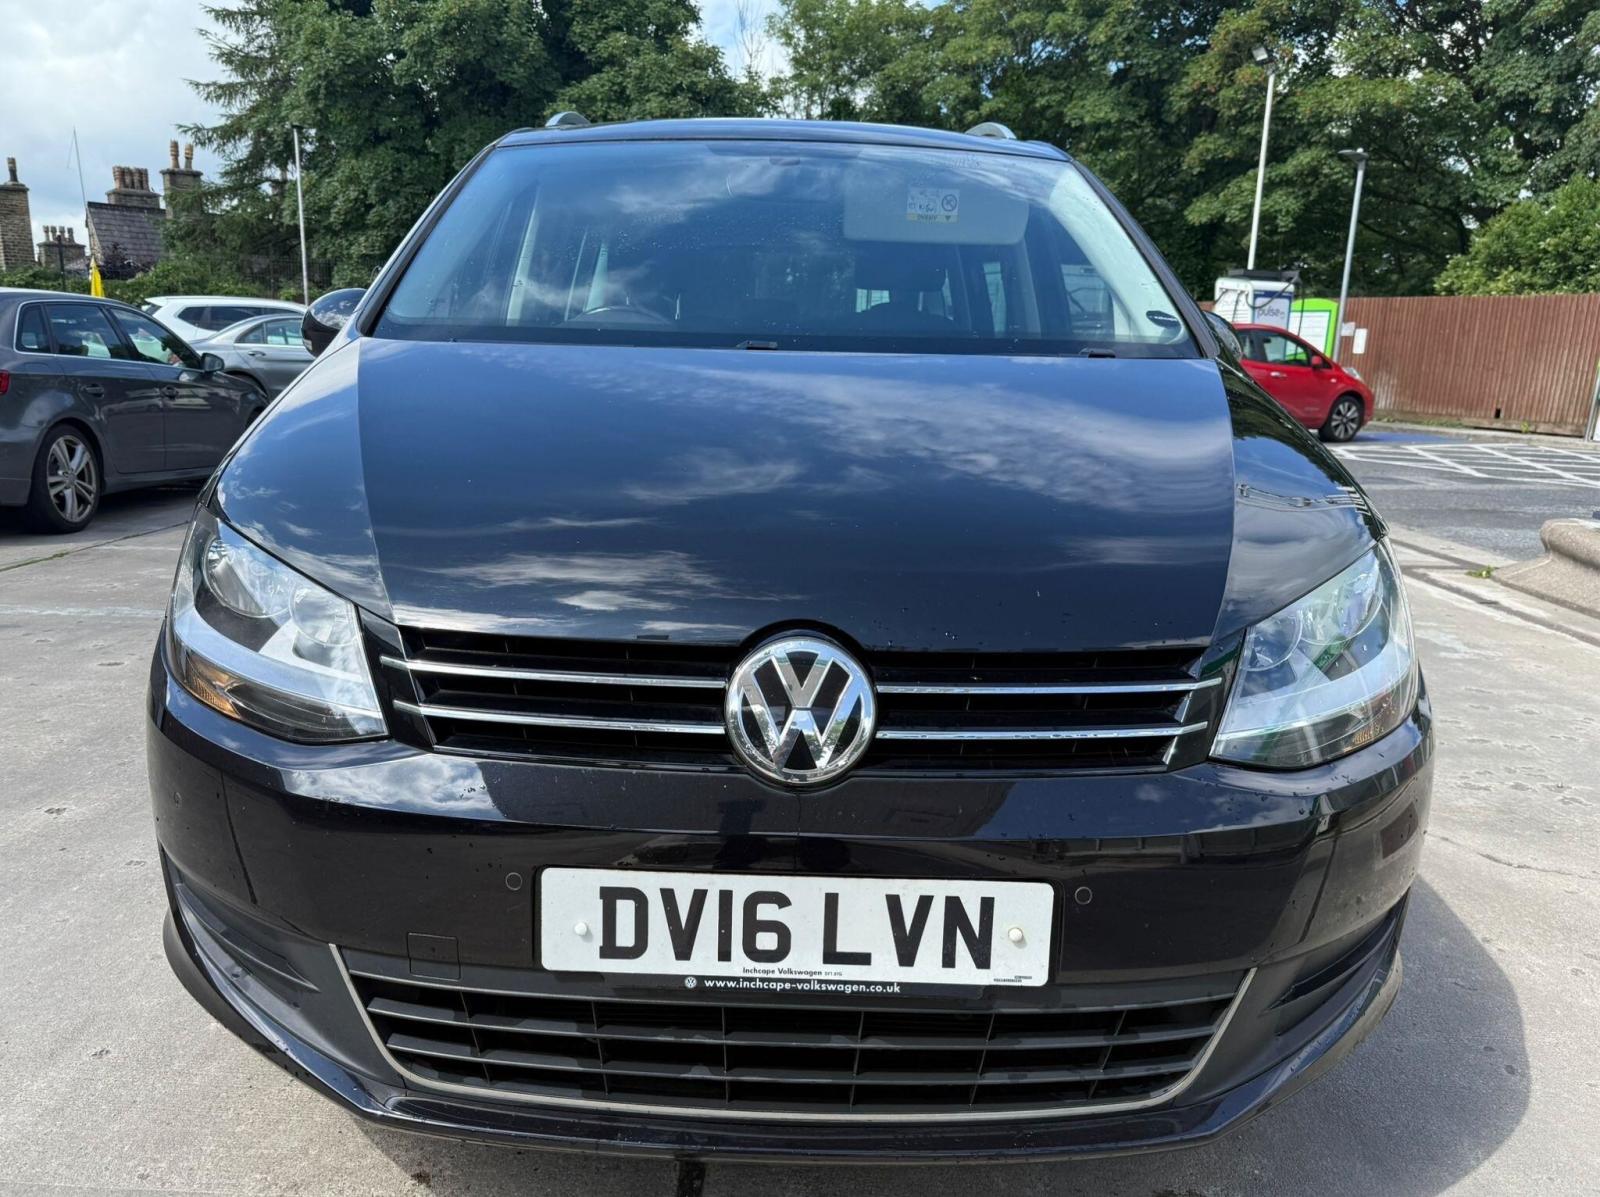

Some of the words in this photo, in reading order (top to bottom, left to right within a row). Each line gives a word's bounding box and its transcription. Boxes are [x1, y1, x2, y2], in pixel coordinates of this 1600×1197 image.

[599, 886, 792, 964] DV16
[823, 892, 995, 970] LVN
[742, 966, 776, 976] Inchcape
[777, 967, 823, 977] Volkswagen
[704, 978, 901, 994] www.inchcape-volkswagen.co.uk
